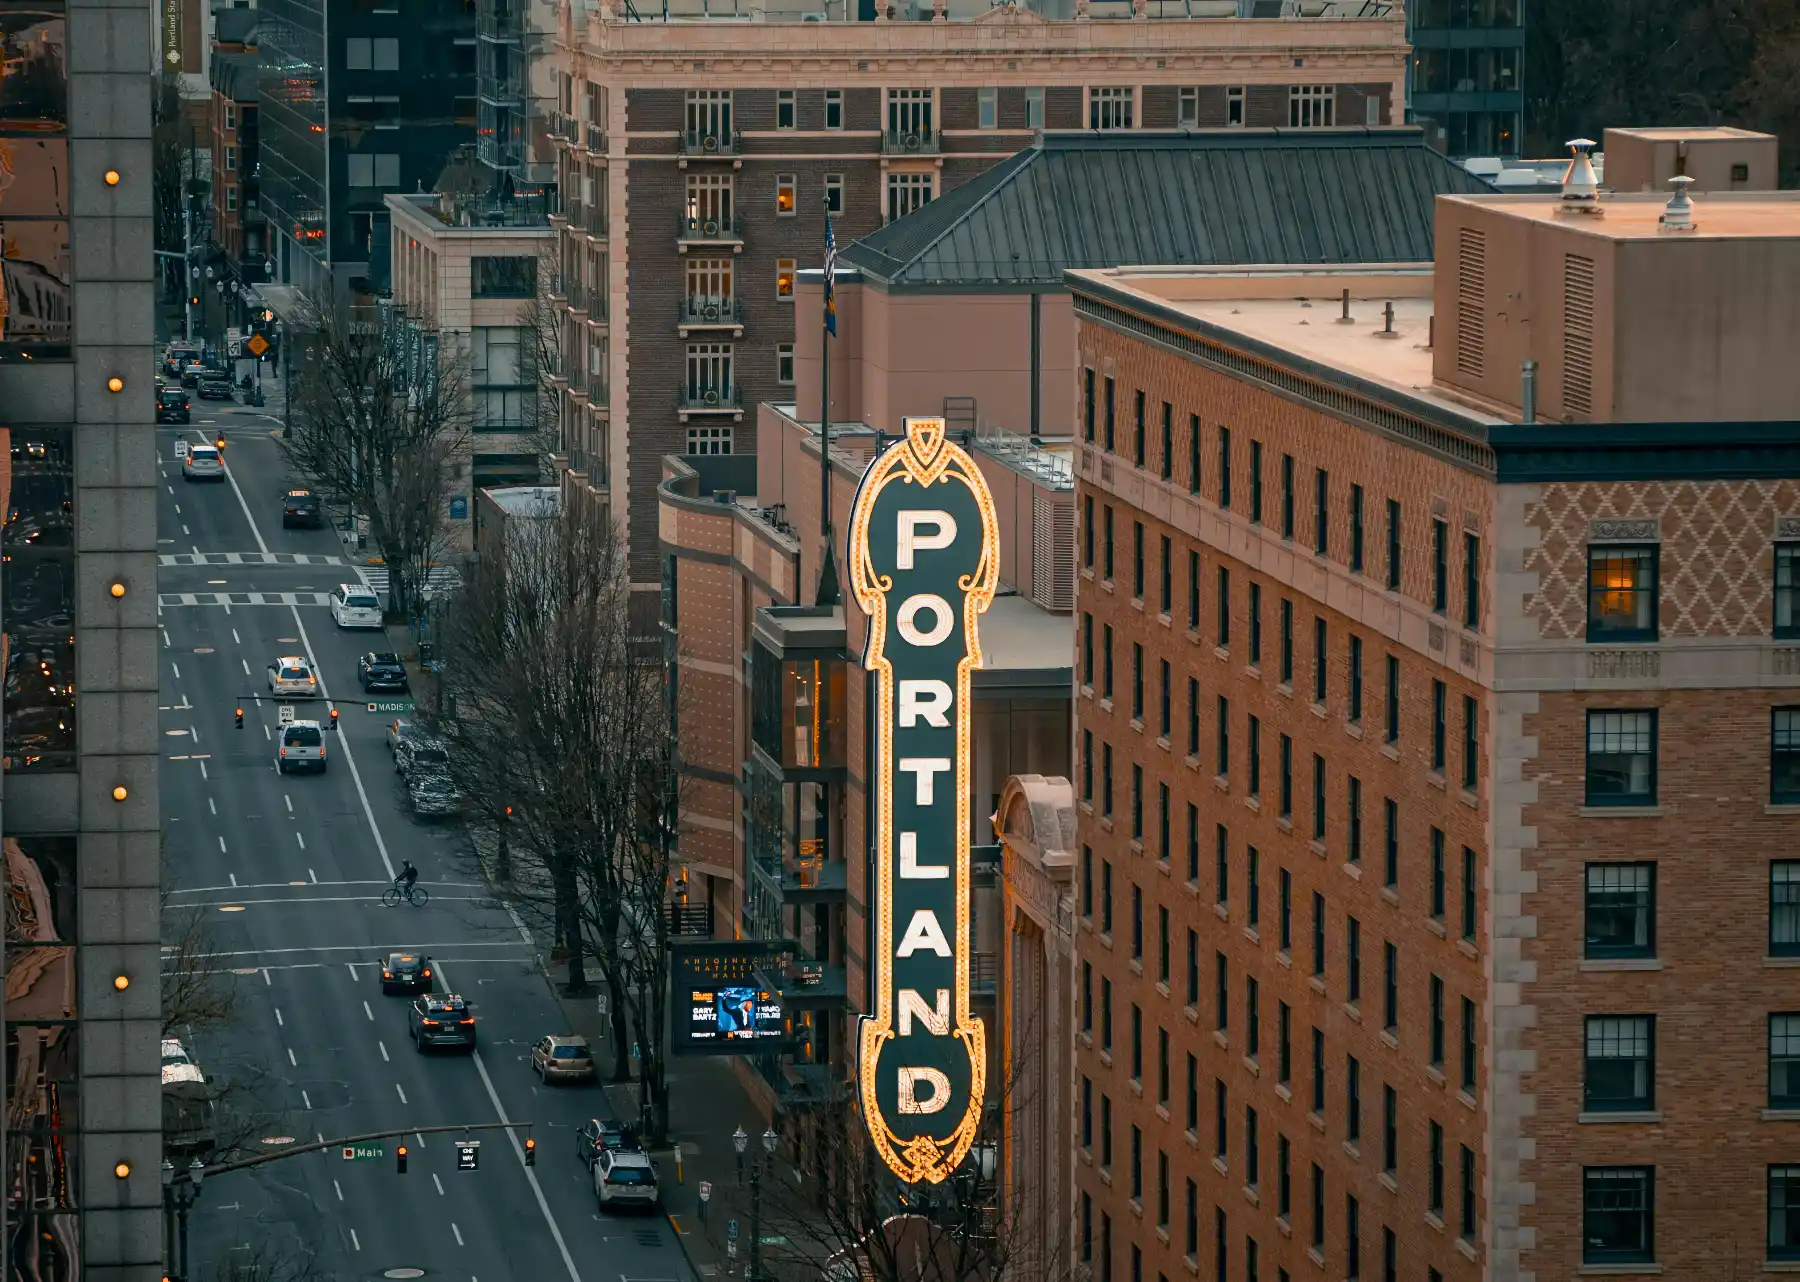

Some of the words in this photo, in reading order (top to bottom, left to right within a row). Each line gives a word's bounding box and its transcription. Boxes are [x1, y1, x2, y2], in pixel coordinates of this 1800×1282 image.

[167, 14, 176, 47] Portland
[378, 703, 416, 711] MADISON
[895, 509, 957, 1116] PORTLAND
[357, 1148, 383, 1157] Main
